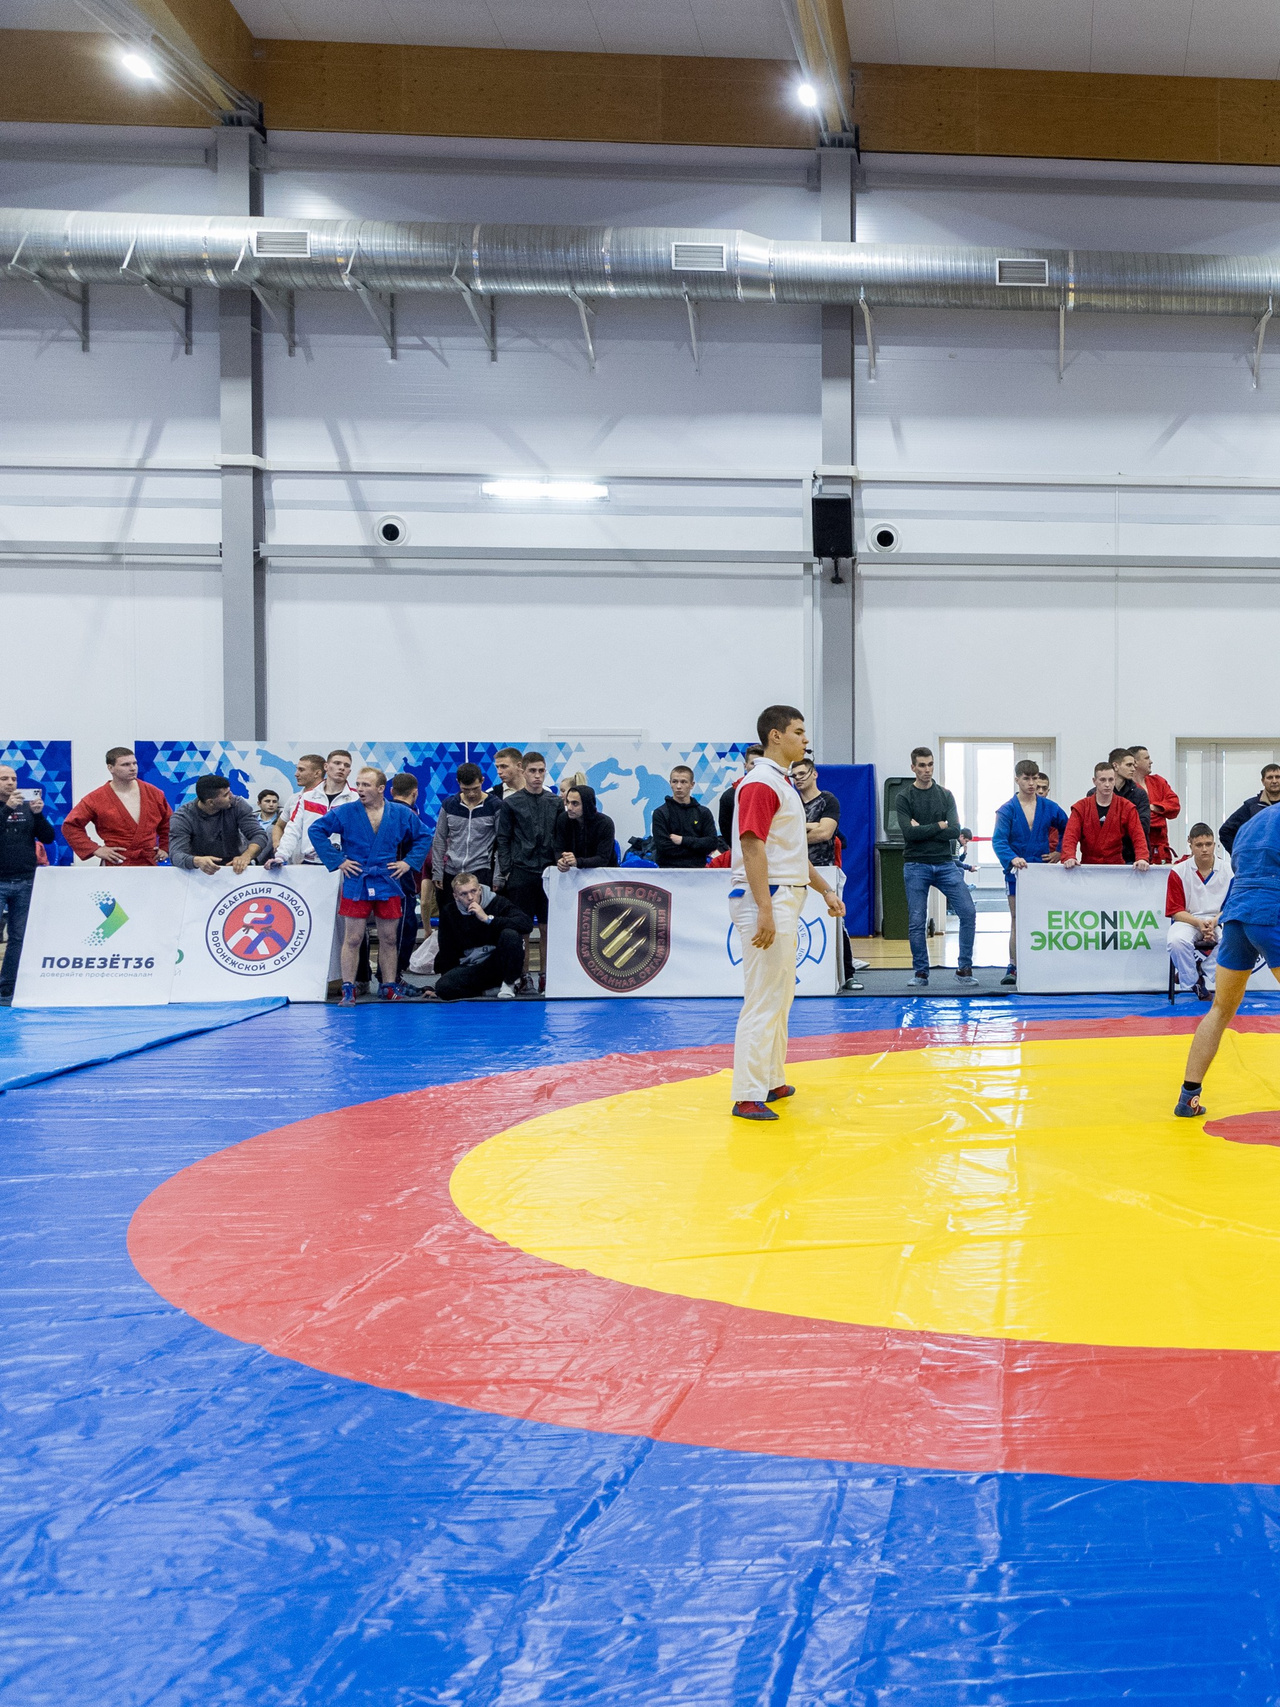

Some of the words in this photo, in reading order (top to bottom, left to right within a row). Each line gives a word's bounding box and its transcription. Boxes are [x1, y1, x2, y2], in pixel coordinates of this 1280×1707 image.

[218, 887, 272, 916] ФЕДЕРАЦИЯ
[278, 891, 305, 917] ДЗЮДО
[1047, 910, 1159, 930] EKONIVA
[211, 930, 266, 971] ВОРОНЕЖСКОЙ
[273, 929, 306, 966] ОБЛАСТИ
[581, 908, 592, 958] ЧАСТНАЯ
[587, 961, 637, 988] ОХРАННАЯ
[639, 909, 667, 979] ОРГАНИЗАЦИЯ
[1030, 931, 1151, 951] ЭКОНИВА
[41, 953, 155, 969] ПОВЕЗЁТ36
